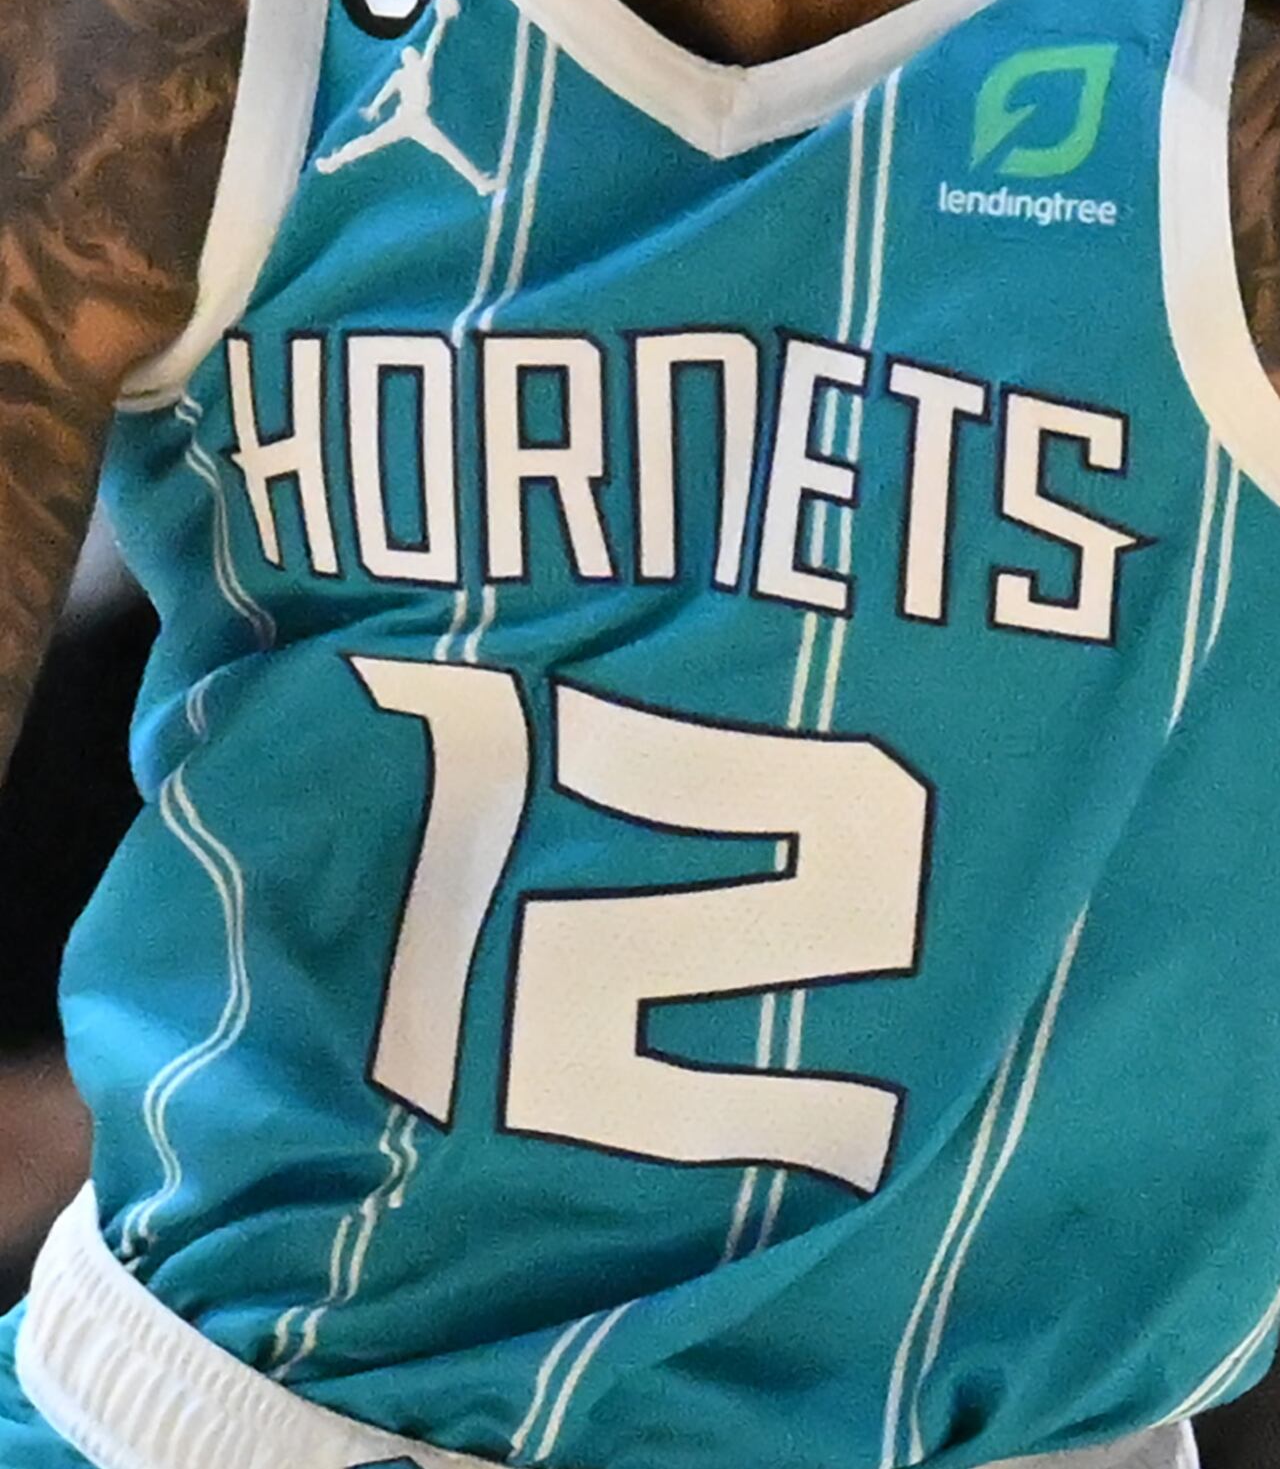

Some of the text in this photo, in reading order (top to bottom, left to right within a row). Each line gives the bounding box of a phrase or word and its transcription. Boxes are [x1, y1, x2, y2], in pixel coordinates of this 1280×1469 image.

[937, 181, 1118, 226] lendingtree
[224, 327, 1157, 645] HORNETS
[340, 652, 936, 1198] 12
